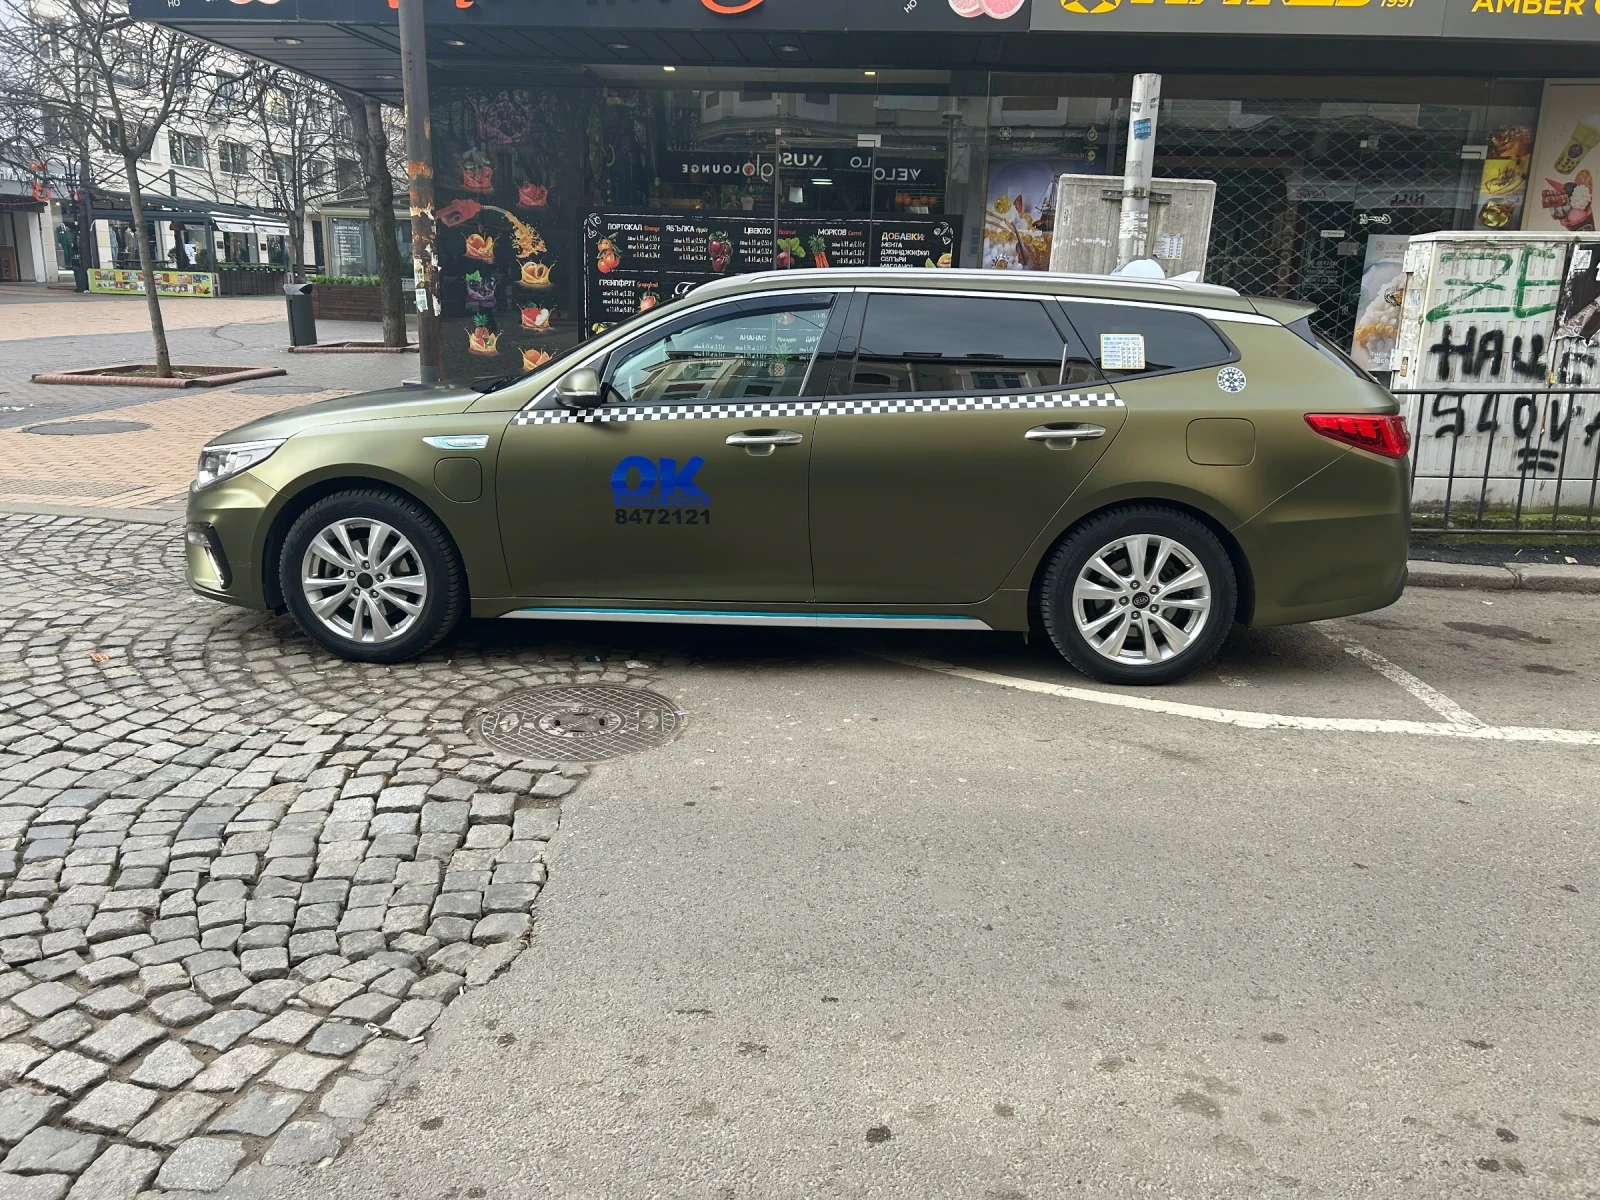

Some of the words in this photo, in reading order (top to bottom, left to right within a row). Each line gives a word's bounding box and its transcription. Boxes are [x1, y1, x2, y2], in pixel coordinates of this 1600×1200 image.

[1471, 0, 1583, 16] AMBER
[607, 223, 643, 231] ПОРТОКАЛ
[665, 224, 695, 232] ЯБЪЛКА
[743, 227, 772, 236] ЦВЕКЛО
[817, 228, 847, 236] МОРКОВ
[598, 278, 636, 288] ГРЕЙПФРУТ
[739, 334, 767, 342] АНАНАС
[610, 455, 707, 496] OK
[614, 508, 711, 525] 8472121
